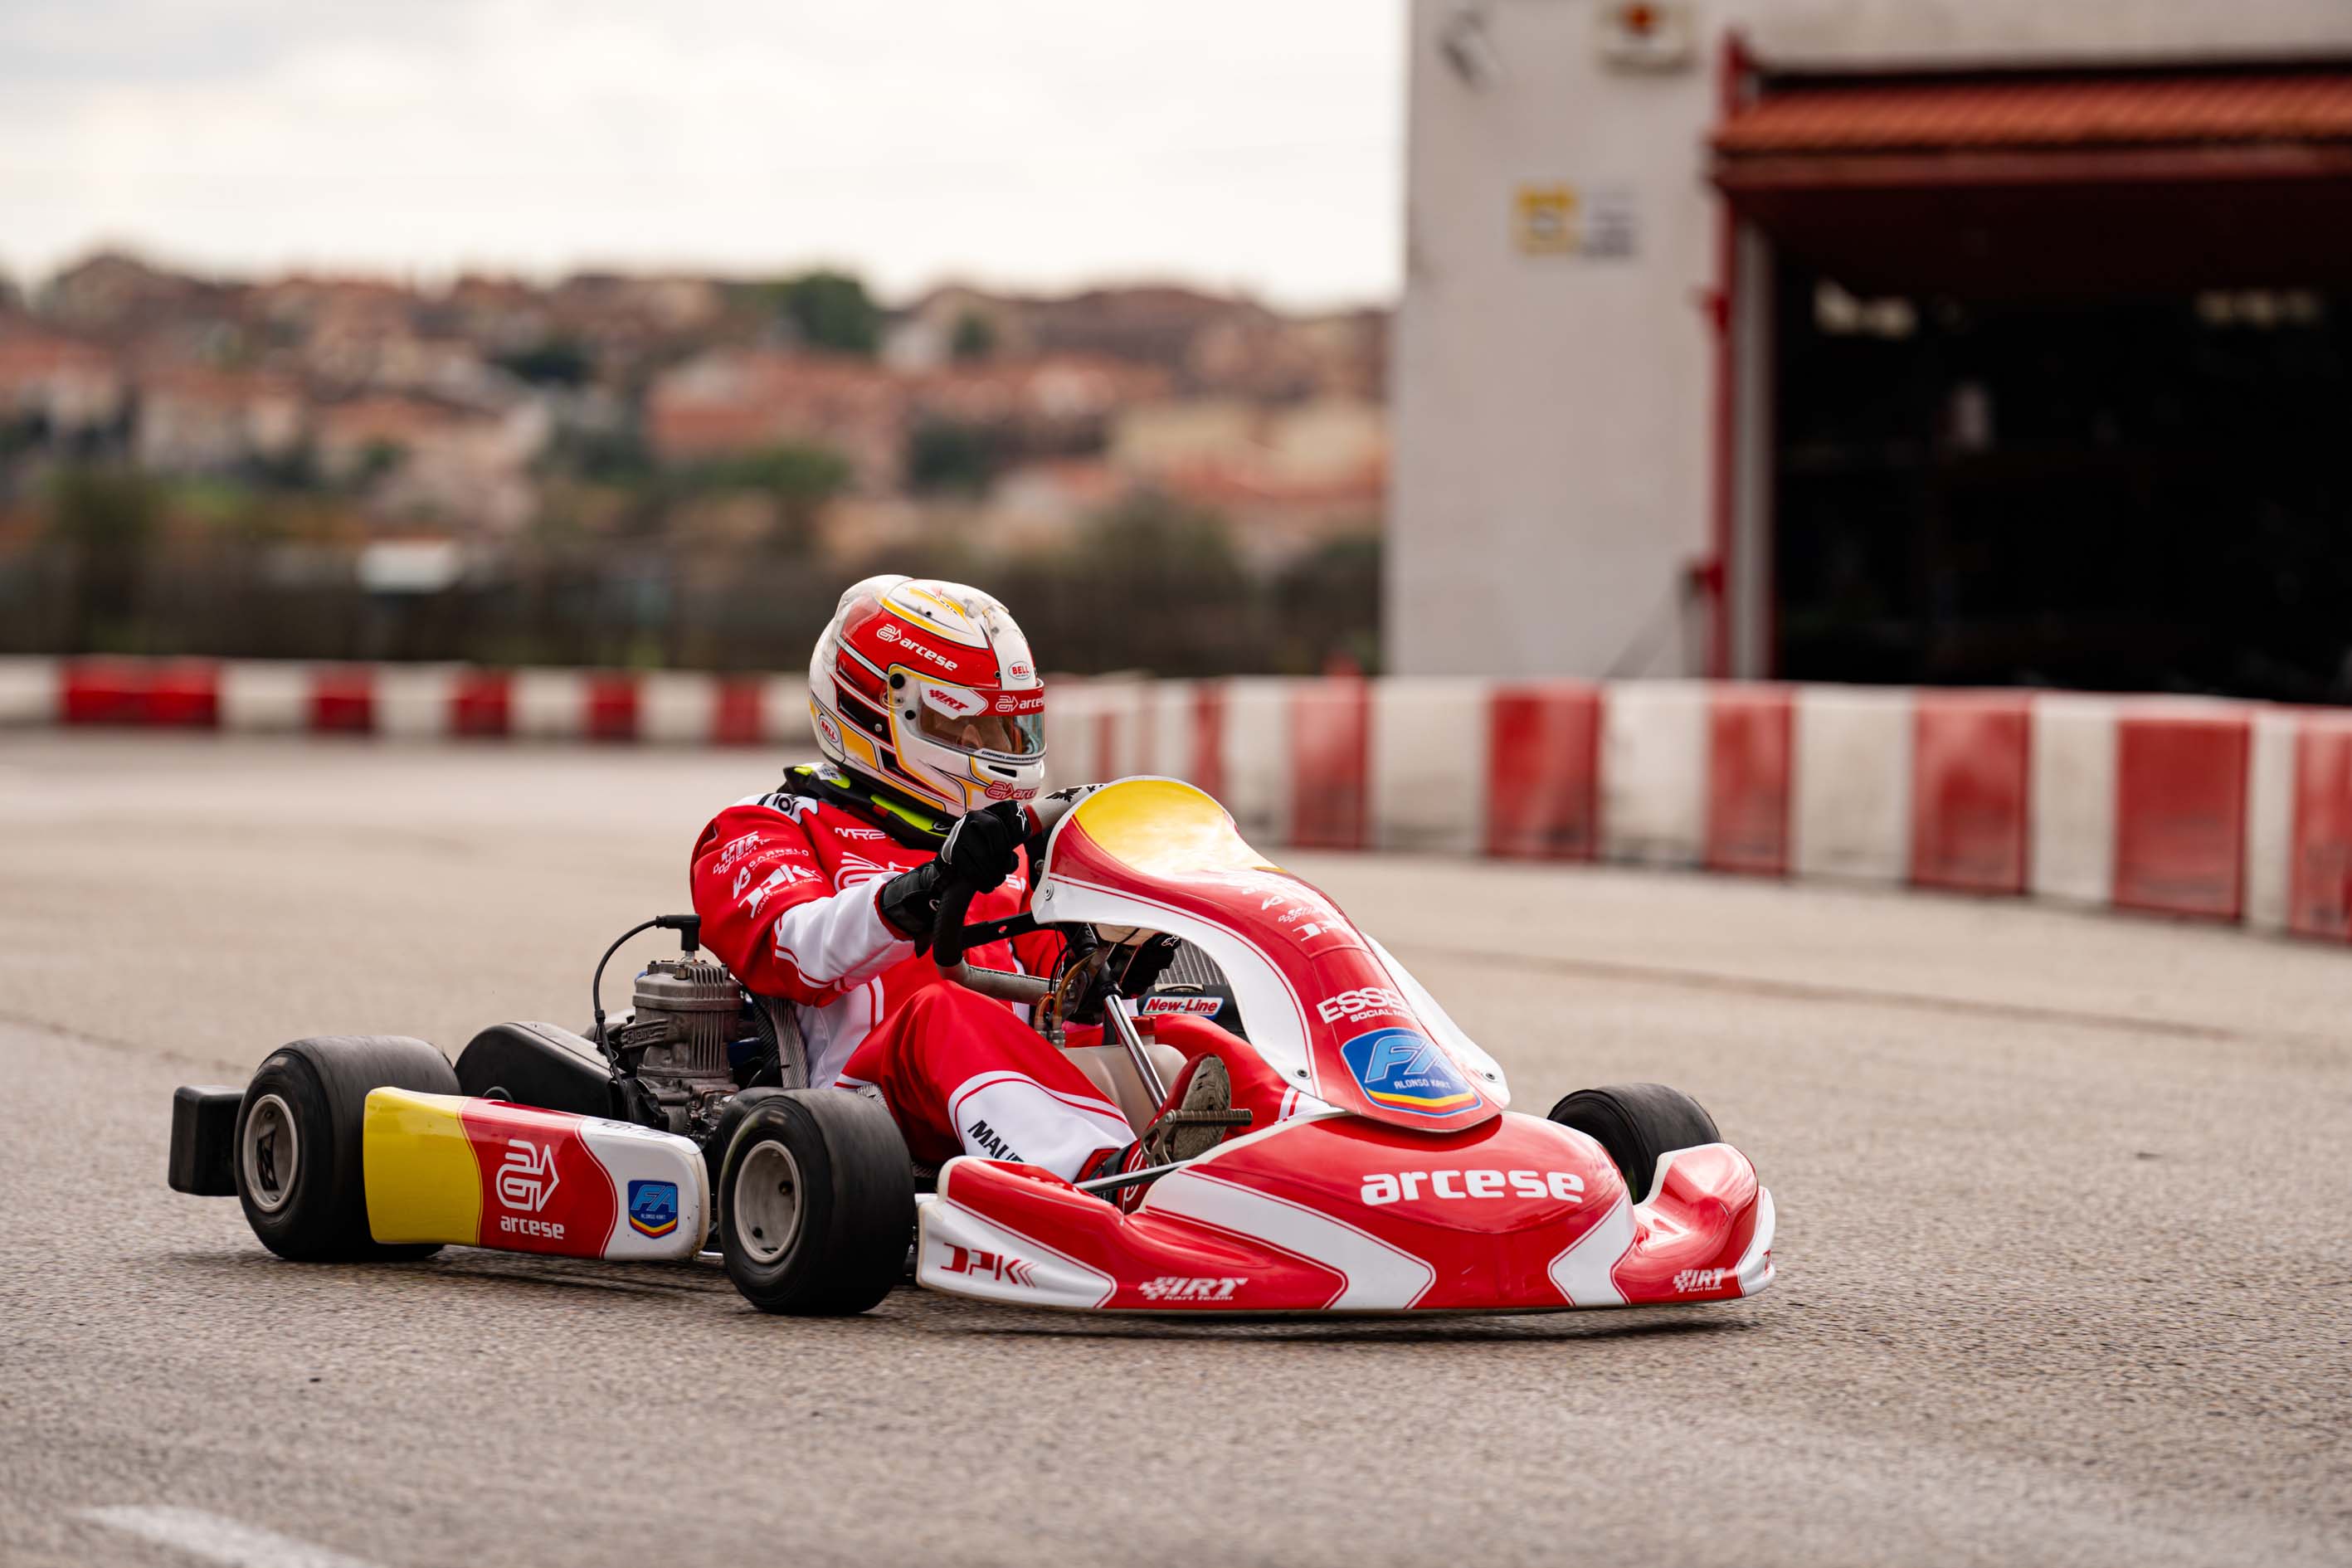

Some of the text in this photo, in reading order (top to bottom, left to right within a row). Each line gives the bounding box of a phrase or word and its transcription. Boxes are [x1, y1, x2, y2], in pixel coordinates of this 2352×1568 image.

[899, 637, 958, 671] arcese
[1012, 665, 1030, 675] BELL
[821, 719, 837, 741] BELL
[1146, 999, 1218, 1011] New-Line
[1349, 1008, 1393, 1022] SOCIAL
[1394, 1079, 1429, 1090] ALONSO
[631, 1184, 677, 1212] FA
[1361, 1169, 1585, 1206] arcese
[500, 1215, 565, 1239] arcese
